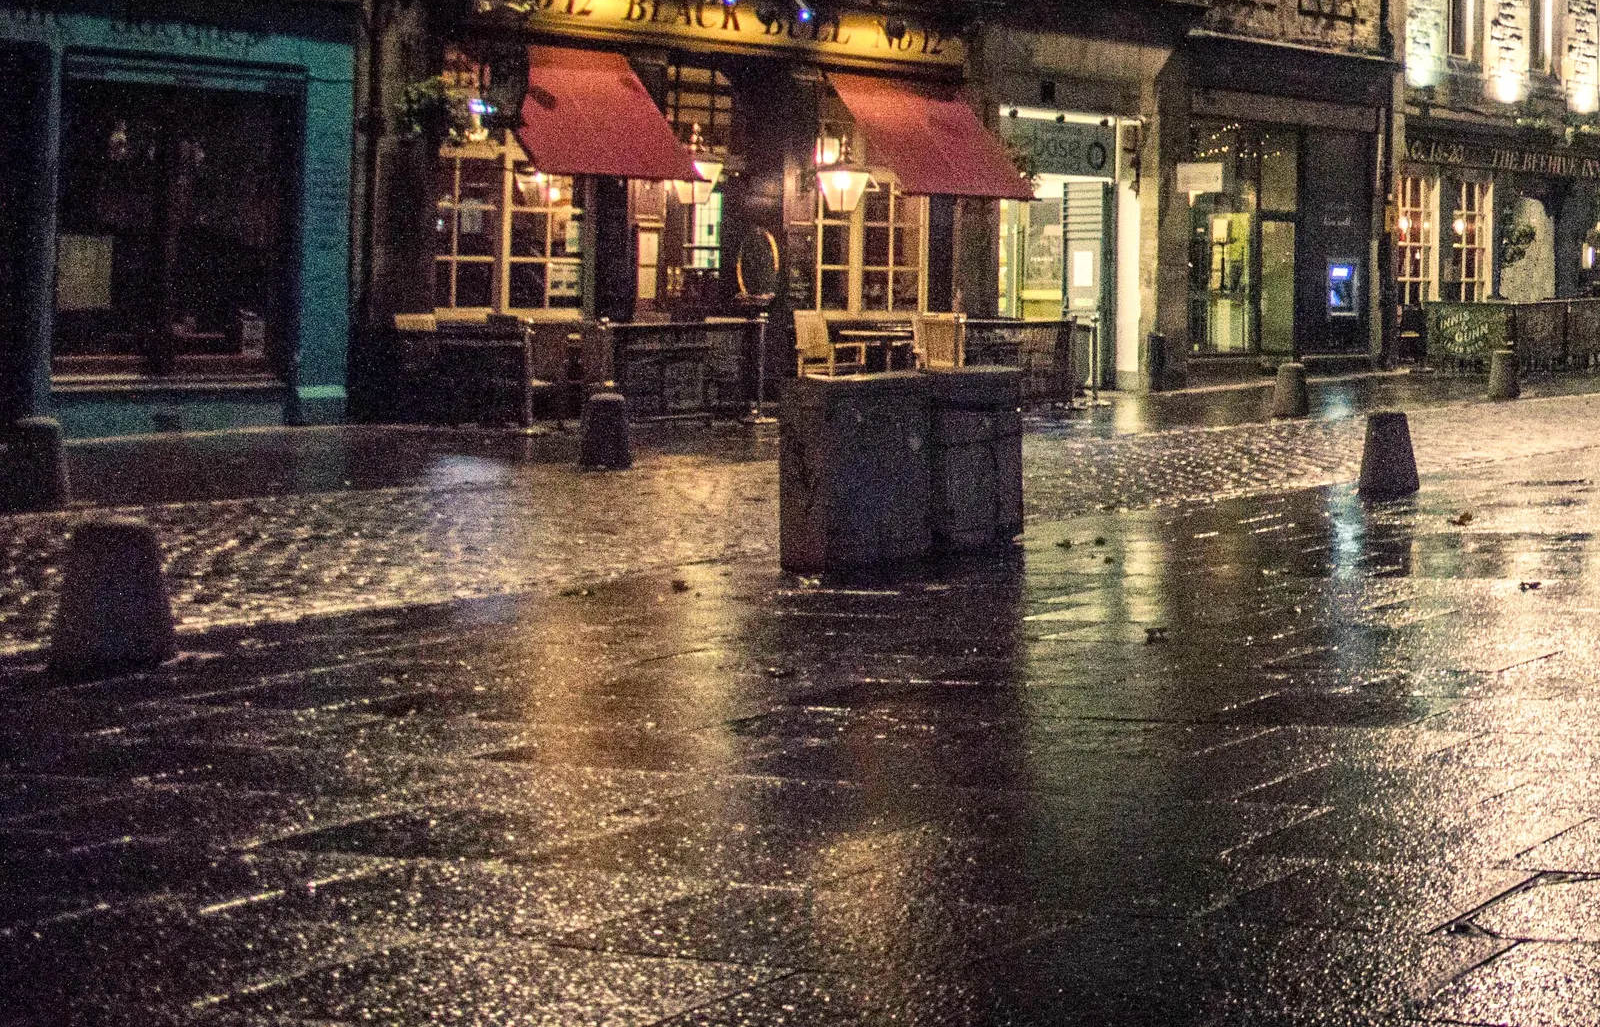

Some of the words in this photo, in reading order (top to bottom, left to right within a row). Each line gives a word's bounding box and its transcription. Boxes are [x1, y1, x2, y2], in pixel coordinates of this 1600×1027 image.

[921, 27, 944, 55] 12
[1490, 148, 1519, 170] THE
[1522, 152, 1578, 176] BEEHIVE
[1439, 310, 1470, 330] INNIS
[1454, 323, 1489, 343] GUNN
